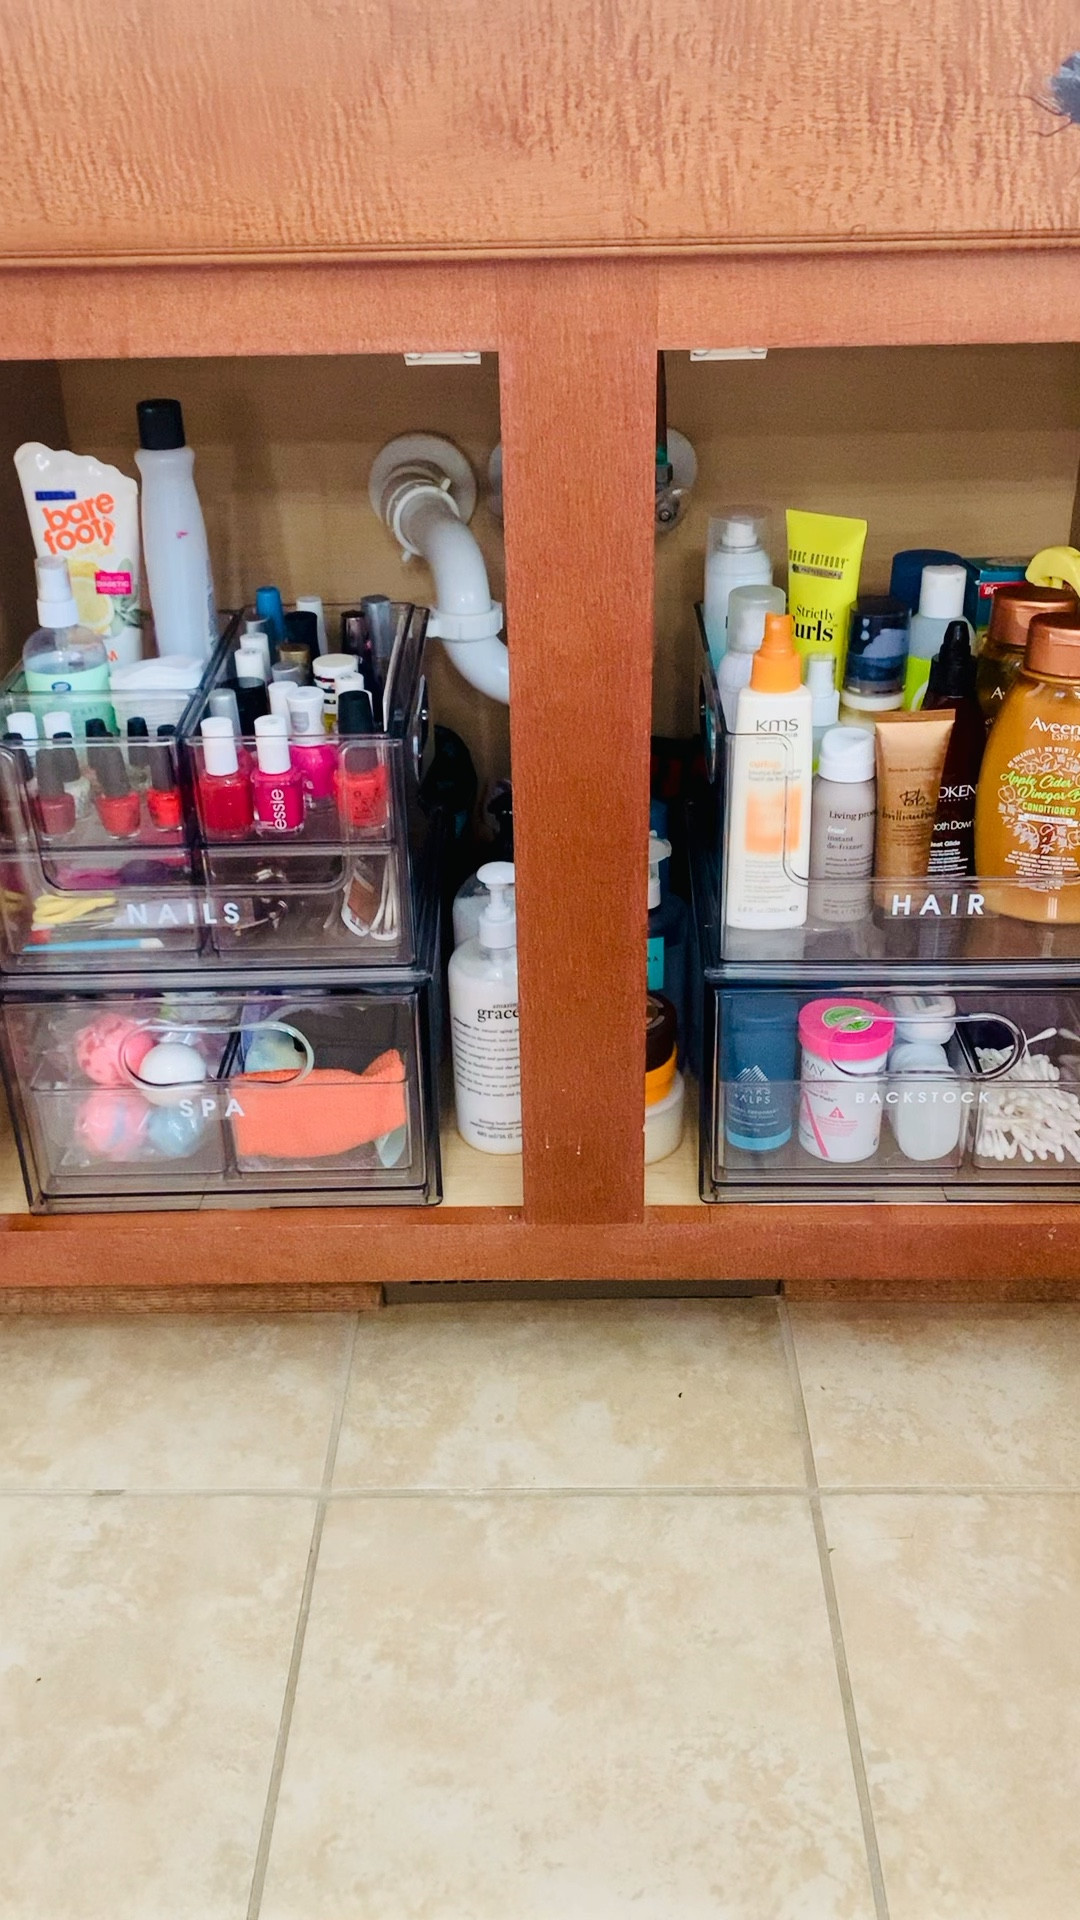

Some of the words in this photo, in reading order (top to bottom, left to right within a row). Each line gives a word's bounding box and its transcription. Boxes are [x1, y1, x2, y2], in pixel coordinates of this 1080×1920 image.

[42, 493, 114, 532] bare
[811, 553, 846, 569] ANTHONY
[795, 604, 835, 623] Strictly
[792, 615, 833, 642] urls
[1029, 716, 1080, 735] Aveen
[1000, 771, 1037, 787] Apple
[1040, 775, 1073, 789] Cider
[938, 784, 976, 799] DKEN
[1018, 785, 1067, 804] Vinegar
[270, 788, 287, 830] essie
[829, 811, 857, 821] Living
[1022, 801, 1076, 816] CONDITIONER
[126, 902, 240, 925] NAILS
[892, 894, 985, 915] HAIR
[477, 1008, 519, 1023] grace
[855, 1091, 990, 1104] BACKSTOCK
[179, 1098, 245, 1117] SPA
